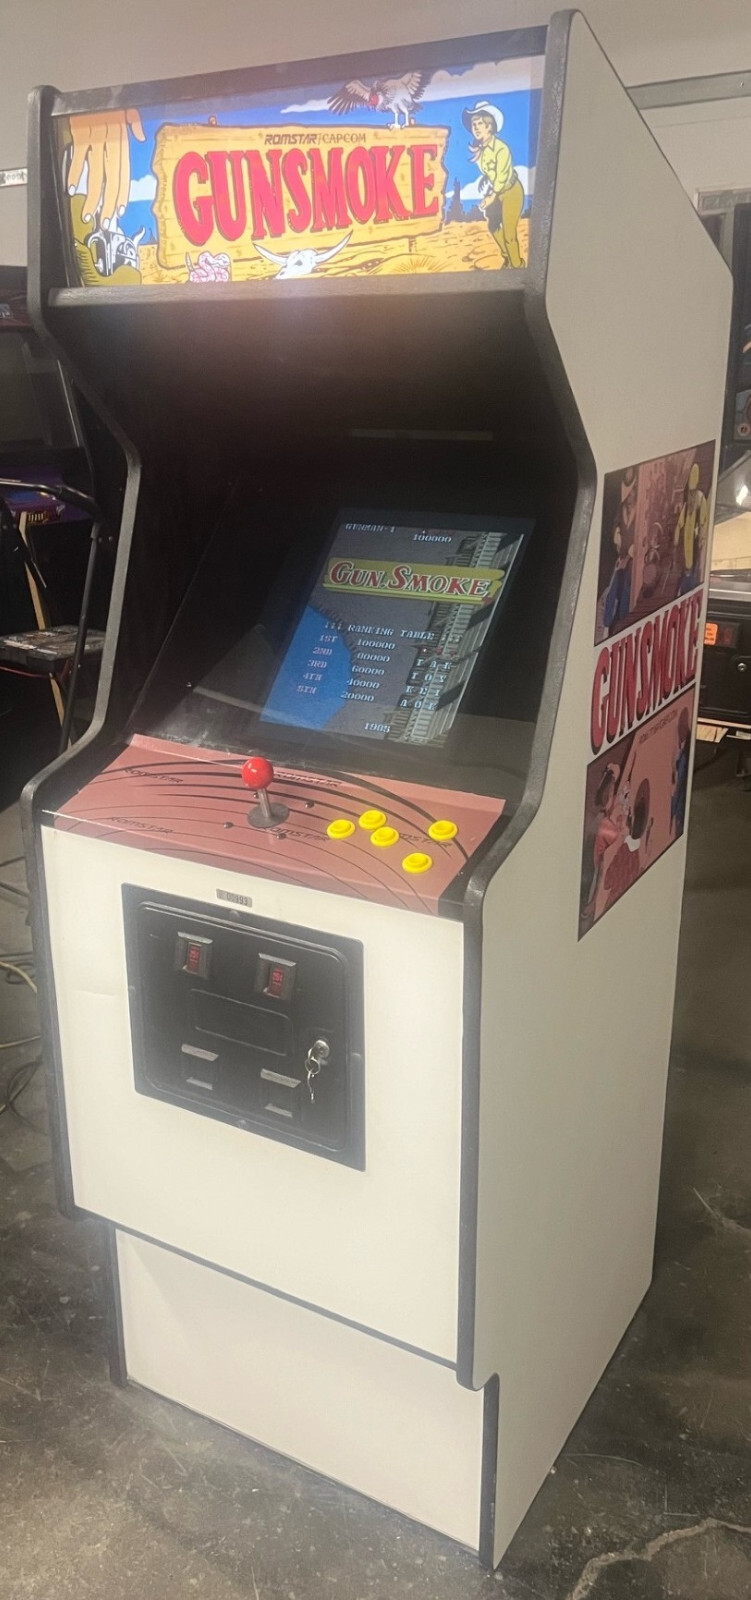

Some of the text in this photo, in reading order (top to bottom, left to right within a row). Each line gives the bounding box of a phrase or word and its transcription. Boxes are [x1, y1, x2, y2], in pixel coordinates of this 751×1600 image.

[172, 143, 440, 246] GUNSMOKE
[412, 533, 452, 544] 100000
[348, 624, 394, 636] RANKING
[400, 629, 435, 640] TABLE
[319, 634, 396, 649] 1ST 100000
[313, 647, 333, 656] 2ND
[307, 659, 328, 669] 3RD
[303, 672, 323, 681] 4TH
[591, 589, 703, 755] GUNSMOKE
